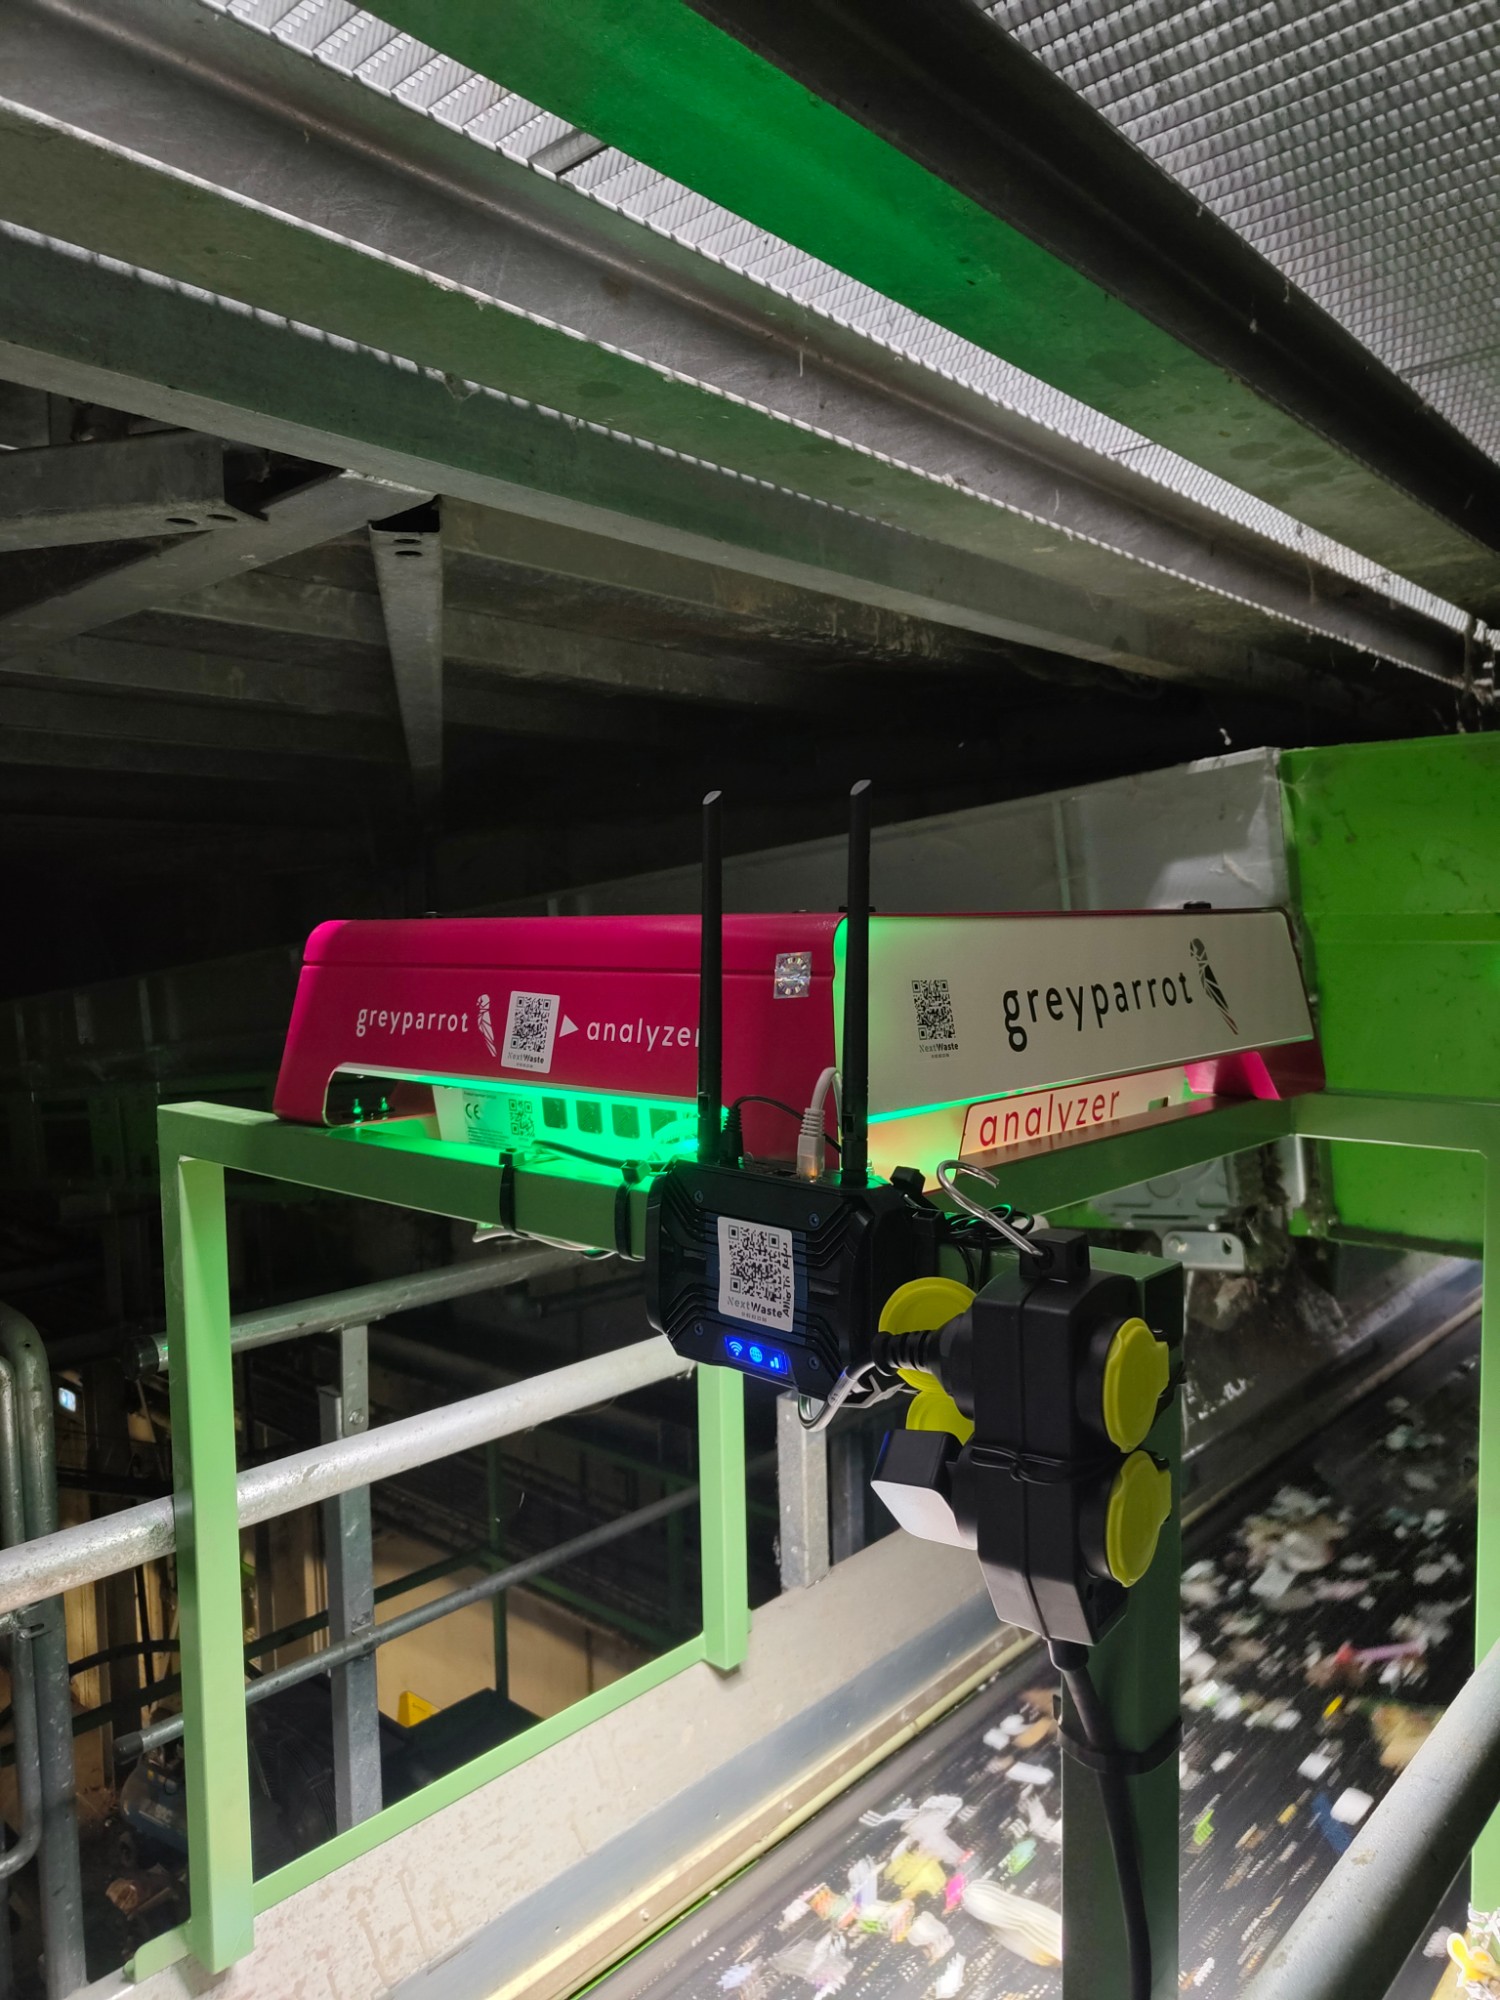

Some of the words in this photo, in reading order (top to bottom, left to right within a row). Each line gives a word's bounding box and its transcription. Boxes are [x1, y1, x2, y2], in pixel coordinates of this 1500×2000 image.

[356, 1008, 468, 1037] greyparrot
[1002, 972, 1193, 1052] greyparrot
[507, 1051, 545, 1064] NextWaste
[919, 1043, 958, 1053] NextWaste
[465, 1102, 480, 1120] CE
[979, 1090, 1120, 1147] analyzer
[726, 1295, 783, 1319] NextWaste
